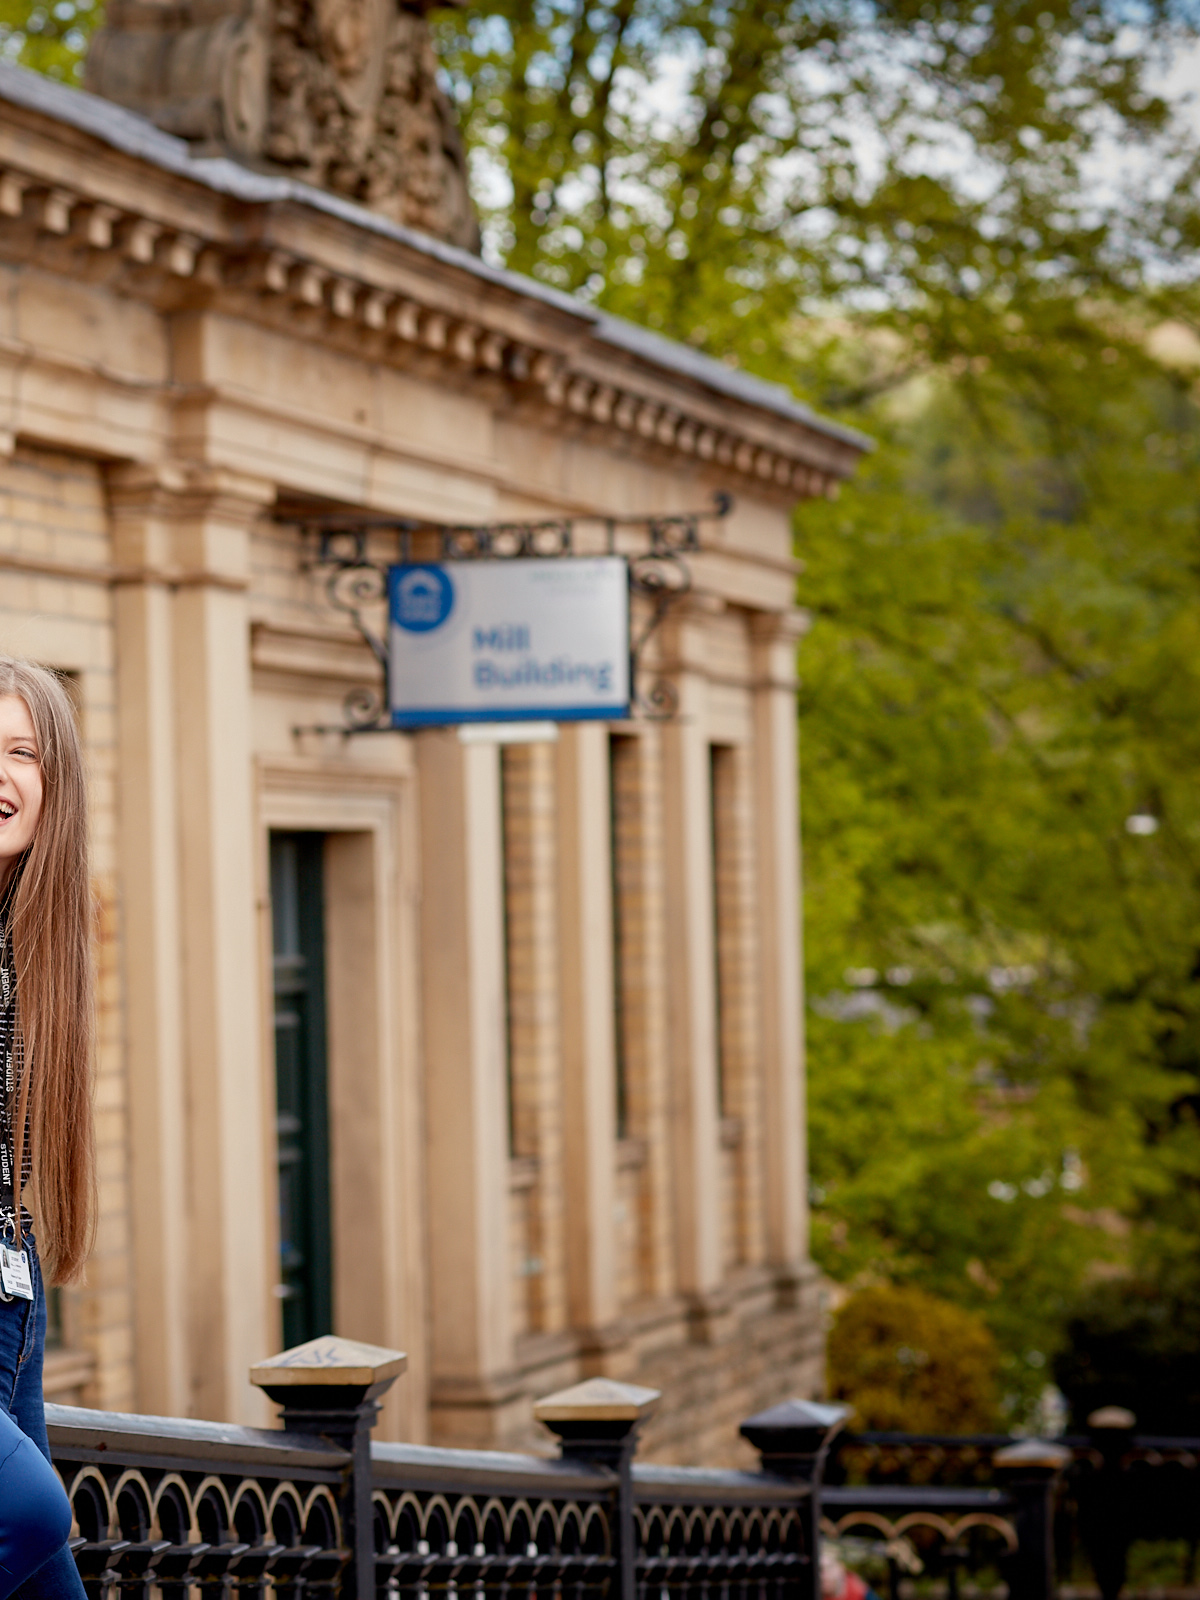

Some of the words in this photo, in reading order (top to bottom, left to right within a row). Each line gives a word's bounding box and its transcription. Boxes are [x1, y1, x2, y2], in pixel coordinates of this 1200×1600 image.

[473, 624, 529, 649] Mill
[475, 658, 613, 693] Building
[6, 1051, 14, 1092] STUDENT
[0, 1143, 11, 1186] STUDENT
